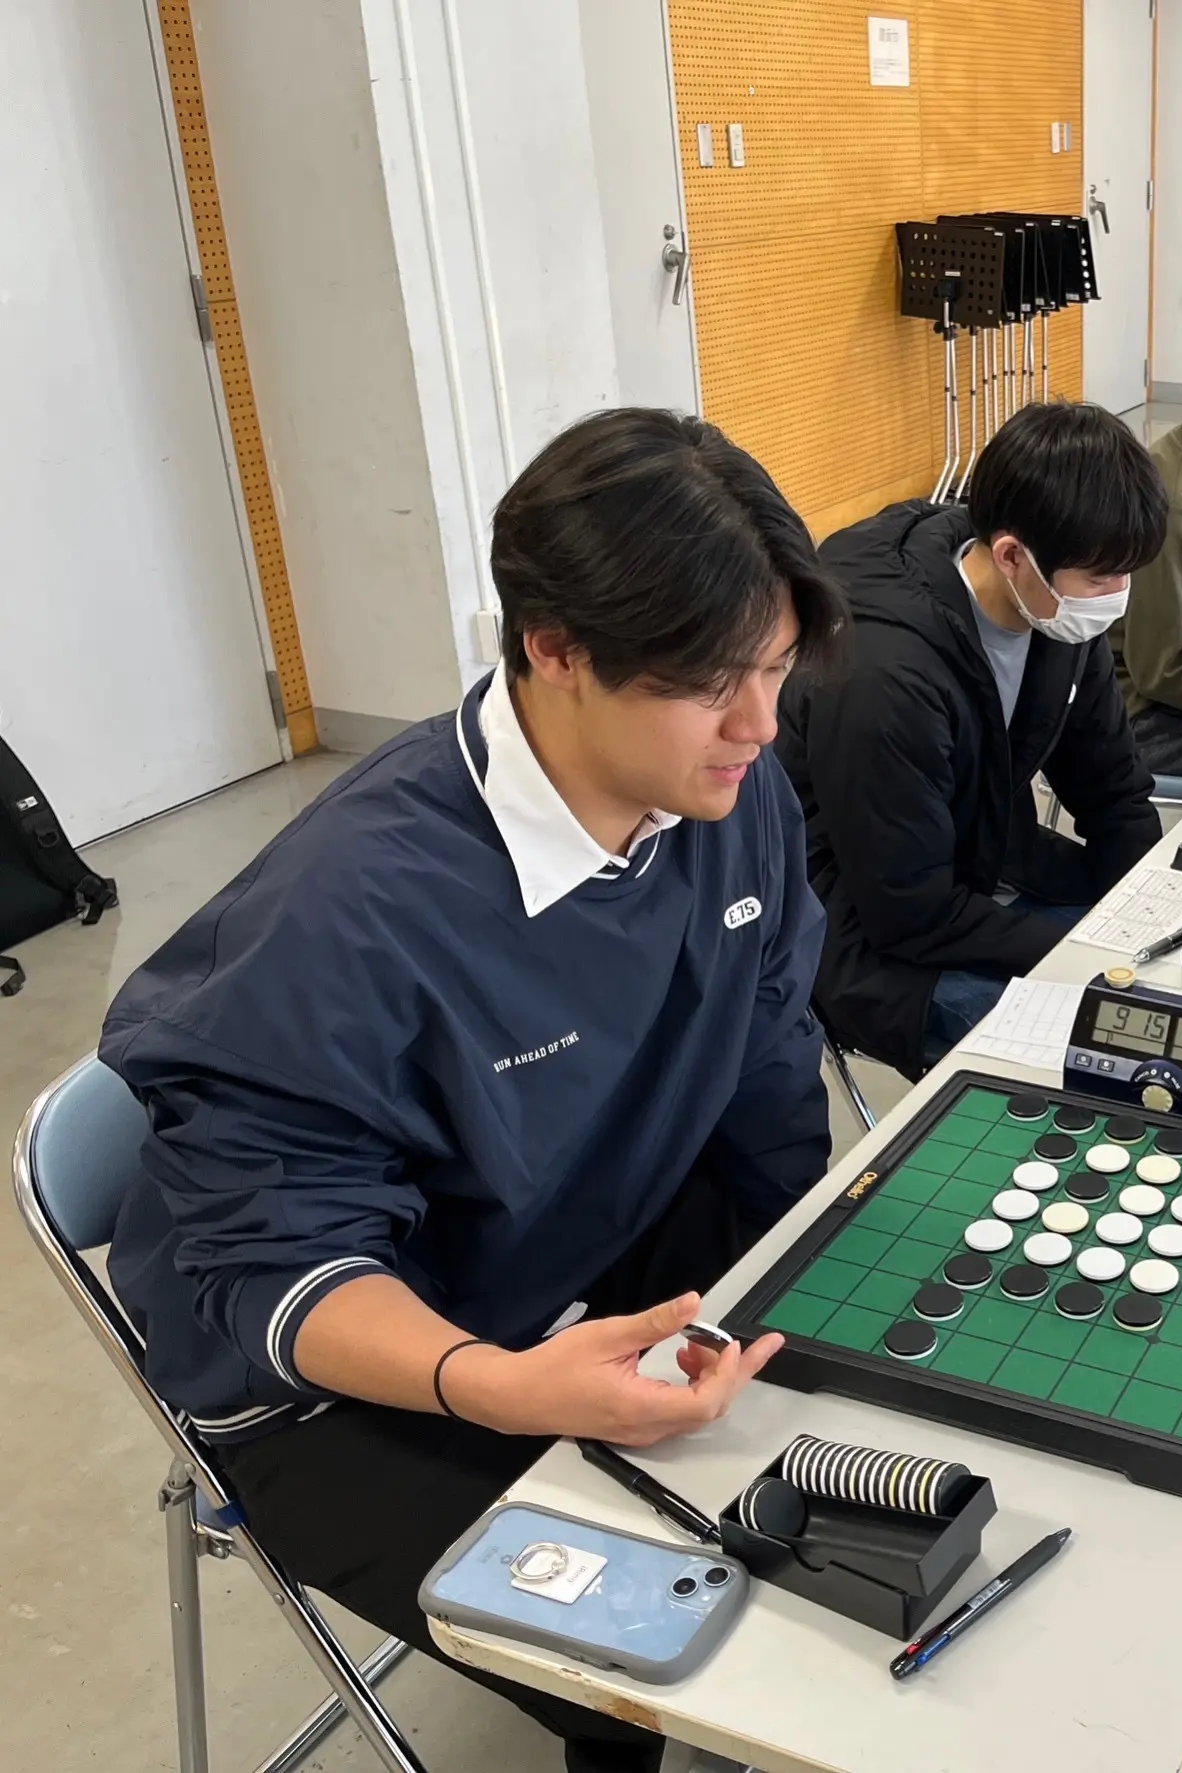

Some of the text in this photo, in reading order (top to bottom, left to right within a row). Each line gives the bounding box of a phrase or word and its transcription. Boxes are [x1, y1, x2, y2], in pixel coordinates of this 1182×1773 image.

[729, 901, 755, 924] E.75
[1113, 1006, 1167, 1039] 9 15
[515, 1047, 547, 1065] AHEAD
[548, 1041, 559, 1053] OF
[560, 1031, 580, 1048] TIME
